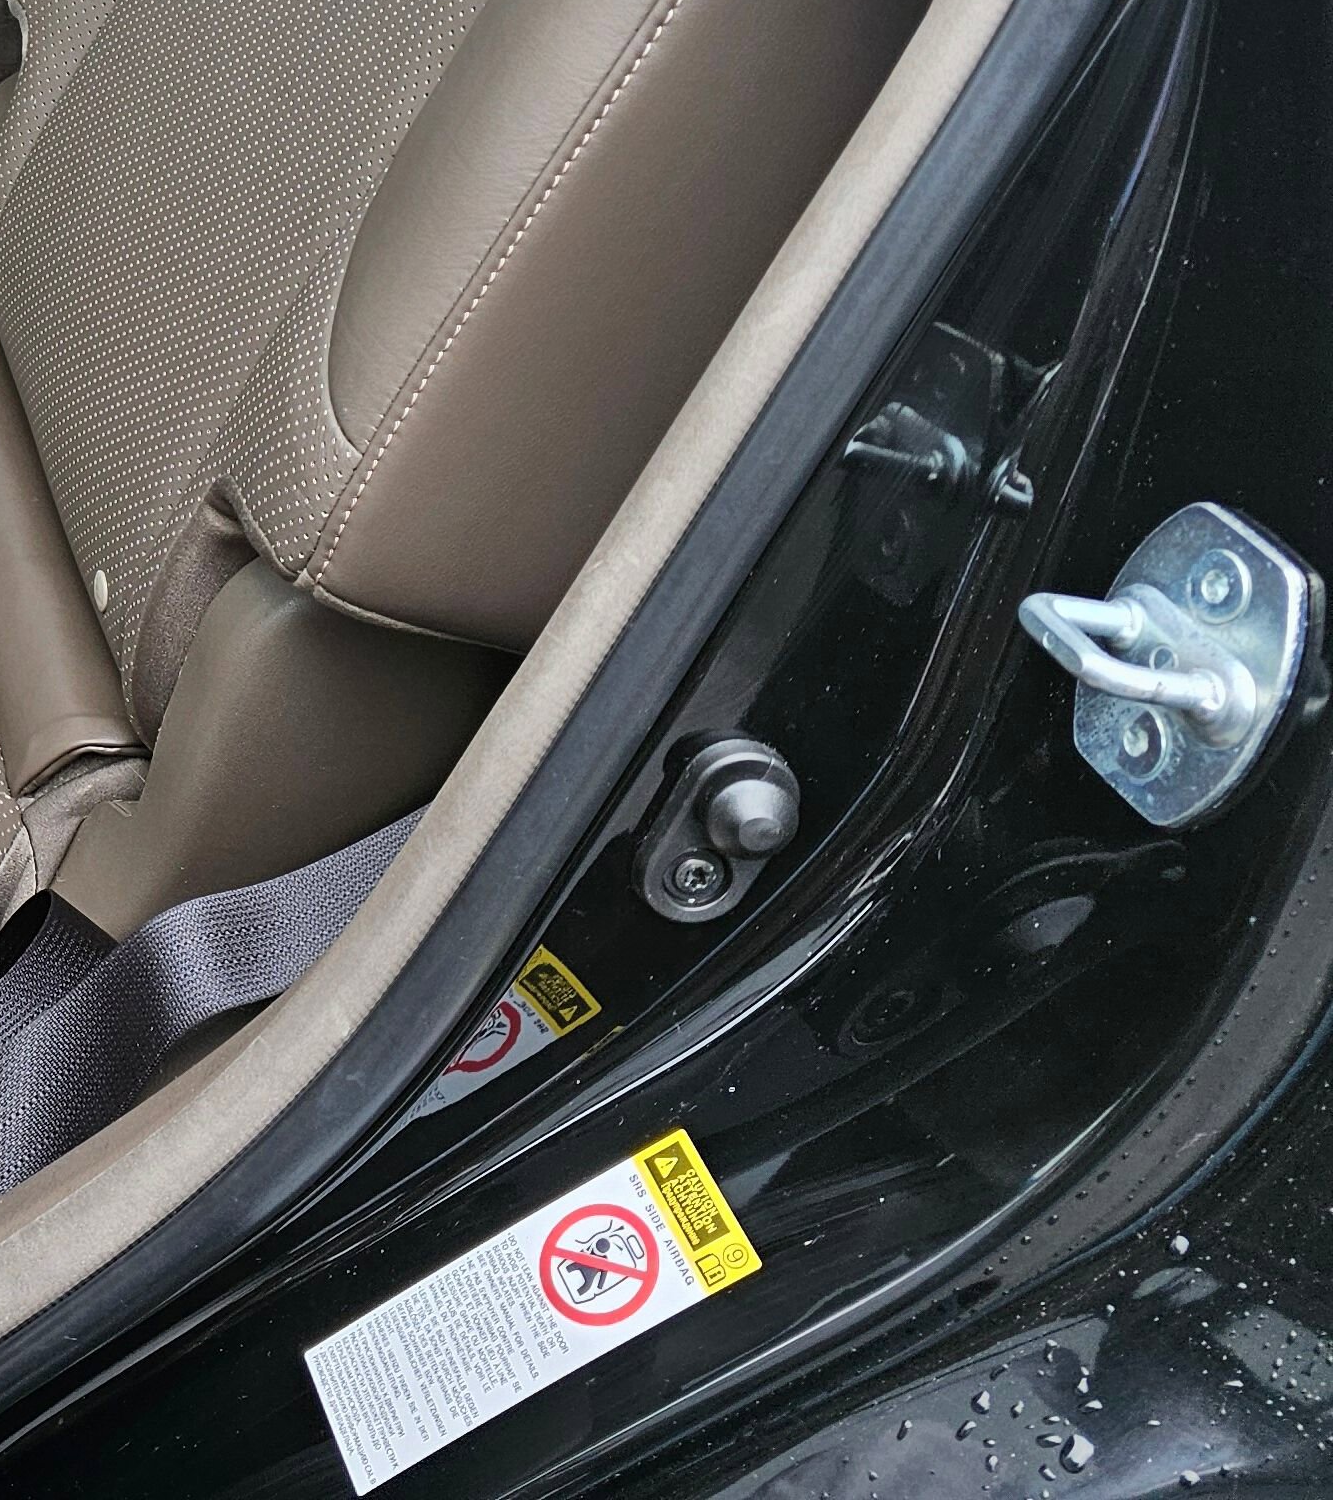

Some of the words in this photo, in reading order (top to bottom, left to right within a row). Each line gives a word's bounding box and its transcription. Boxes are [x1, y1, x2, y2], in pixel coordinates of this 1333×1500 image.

[667, 1176, 705, 1231] ACHTUNG
[675, 1172, 718, 1234] ATTENTION
[683, 1167, 719, 1217] CAUTION
[627, 1173, 647, 1199] SRS
[643, 1202, 666, 1232] SIDE
[662, 1236, 696, 1287] AIRBAG
[724, 1246, 745, 1265] 9
